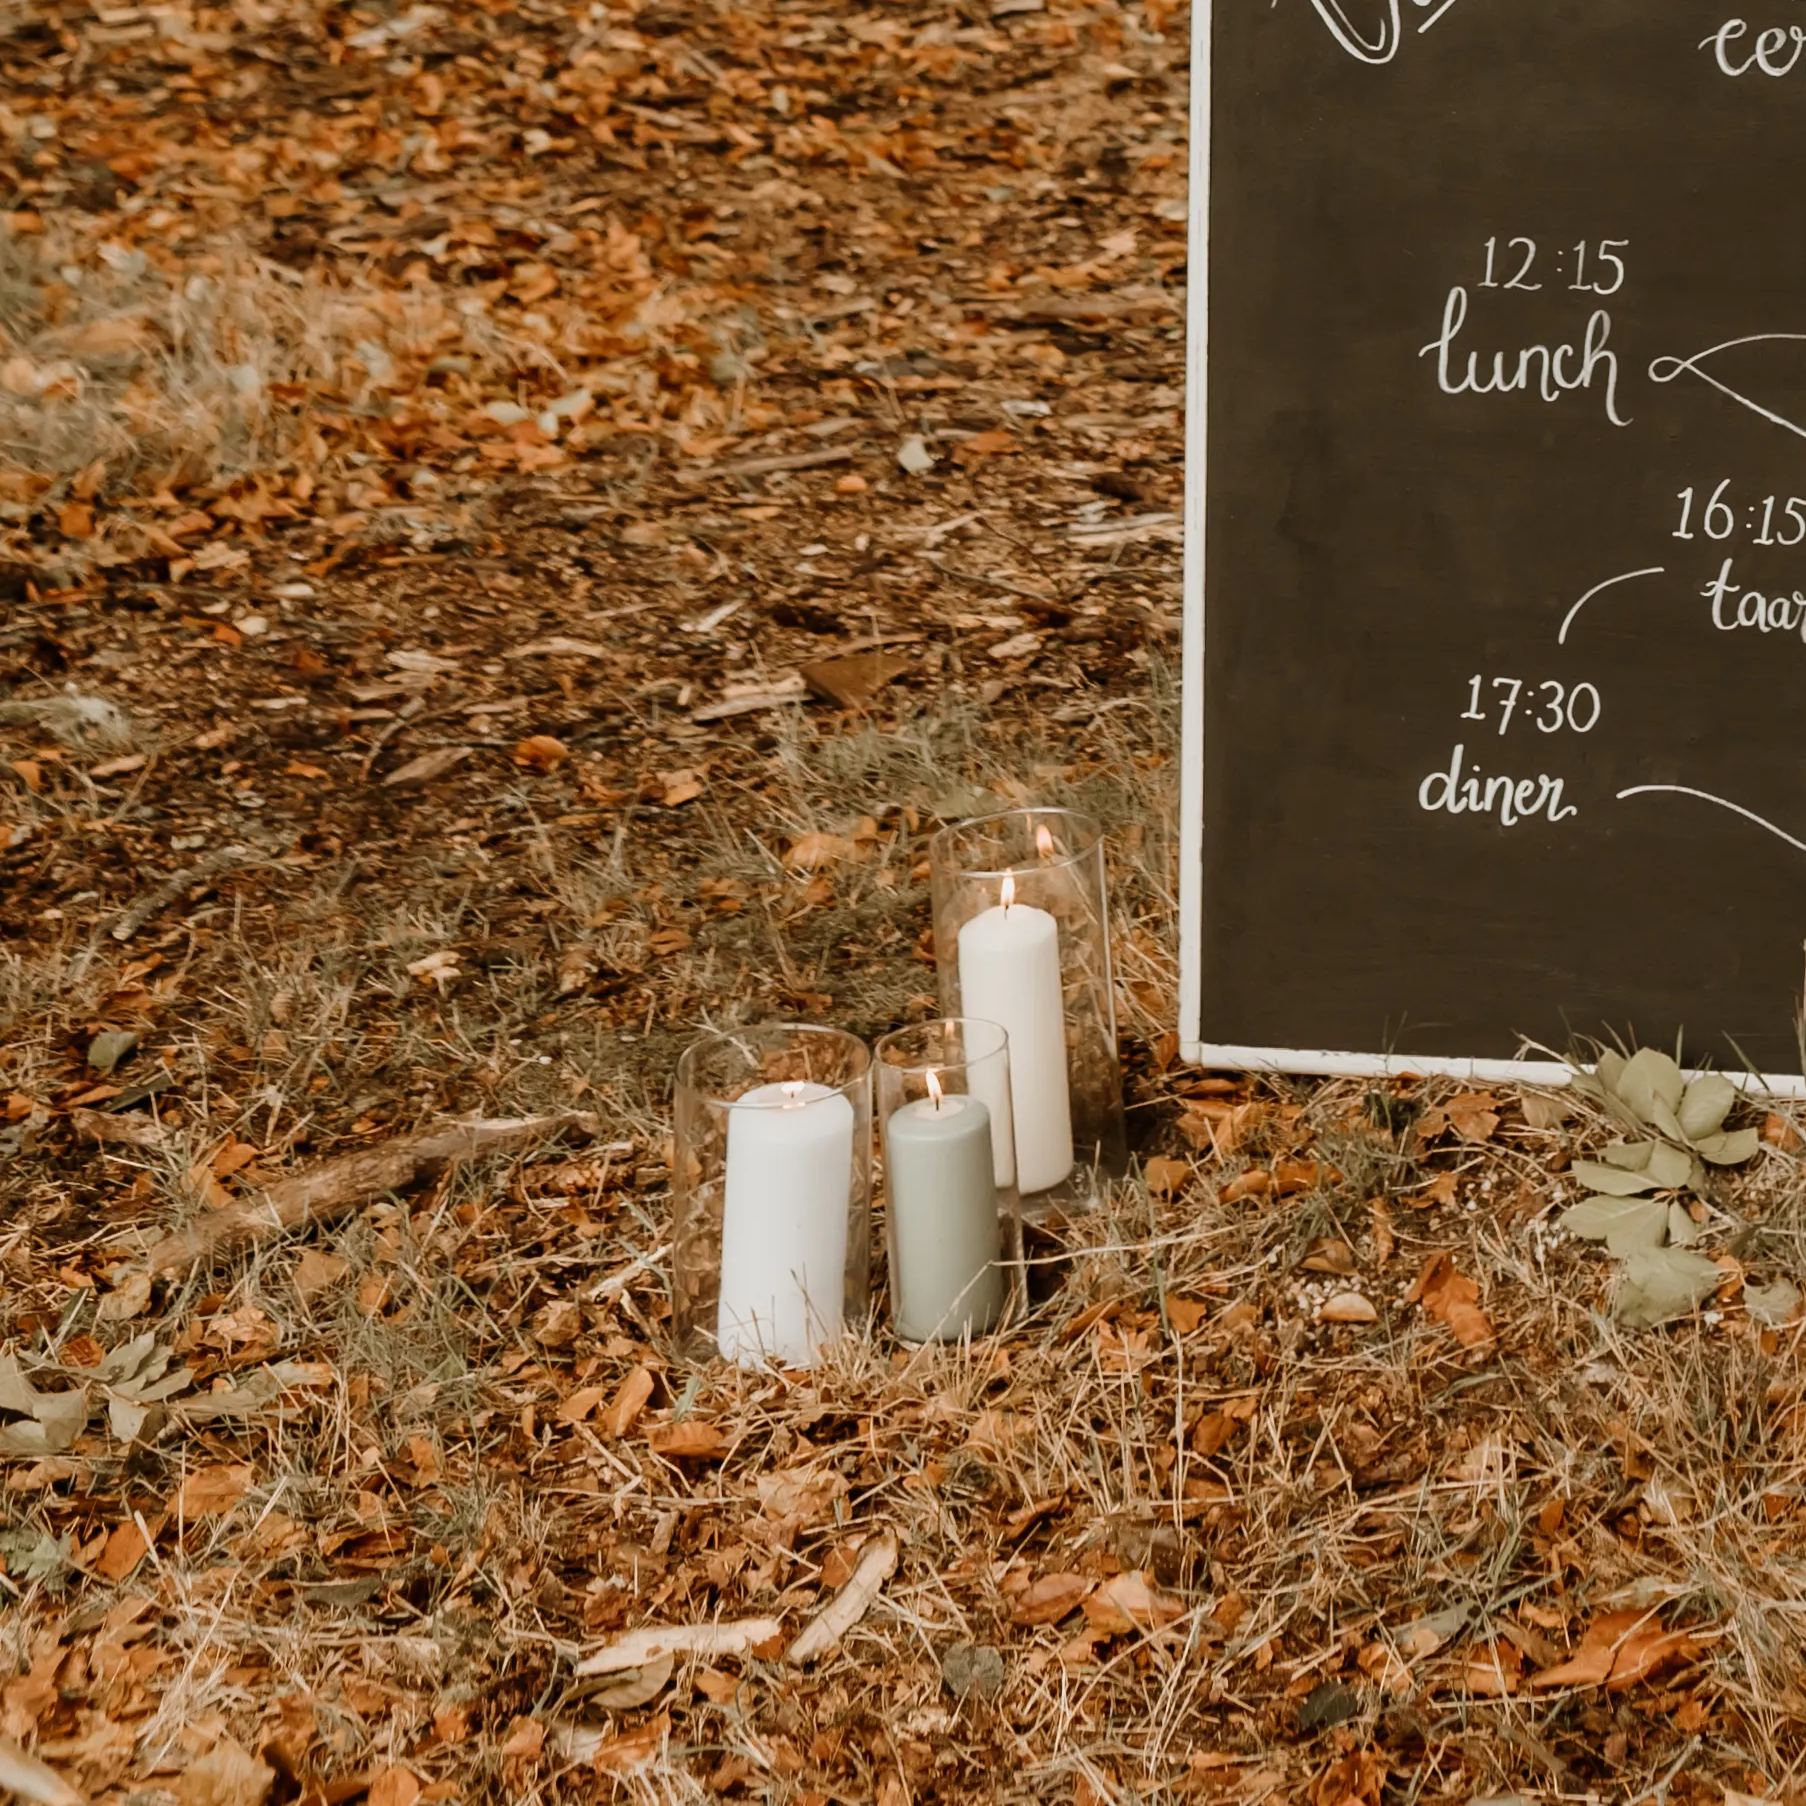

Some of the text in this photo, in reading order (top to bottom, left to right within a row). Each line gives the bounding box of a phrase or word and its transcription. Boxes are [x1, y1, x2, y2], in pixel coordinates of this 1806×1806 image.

[1477, 235, 1630, 295] 12:15
[1418, 287, 1633, 427] lunch
[1459, 673, 1602, 736] 17:30
[1418, 743, 1580, 827] diner
